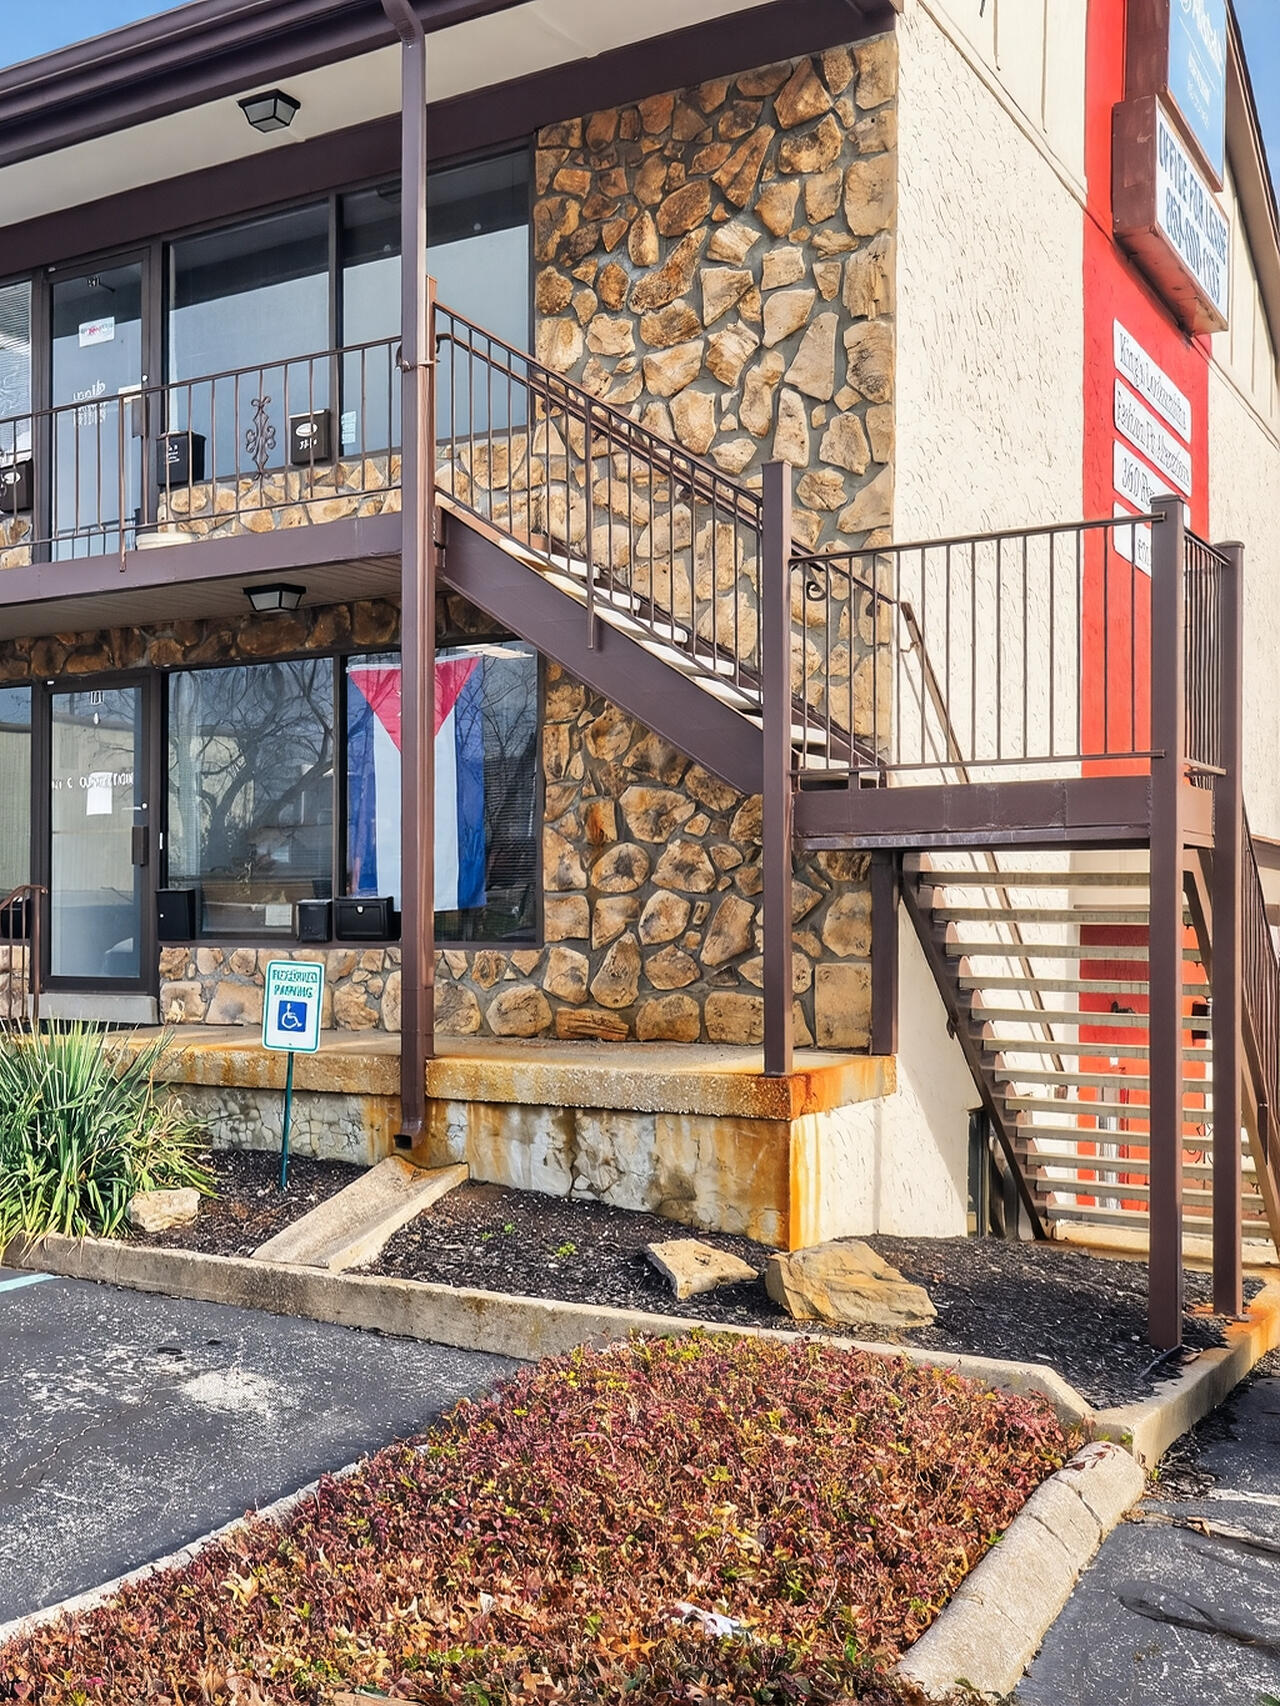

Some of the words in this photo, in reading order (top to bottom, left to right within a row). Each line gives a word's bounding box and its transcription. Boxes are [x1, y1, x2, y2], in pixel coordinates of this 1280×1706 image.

[1159, 121, 1187, 202] OFFICE
[1189, 173, 1204, 225] FOR
[272, 969, 318, 983] RESERVED
[273, 984, 313, 998] PARKING
